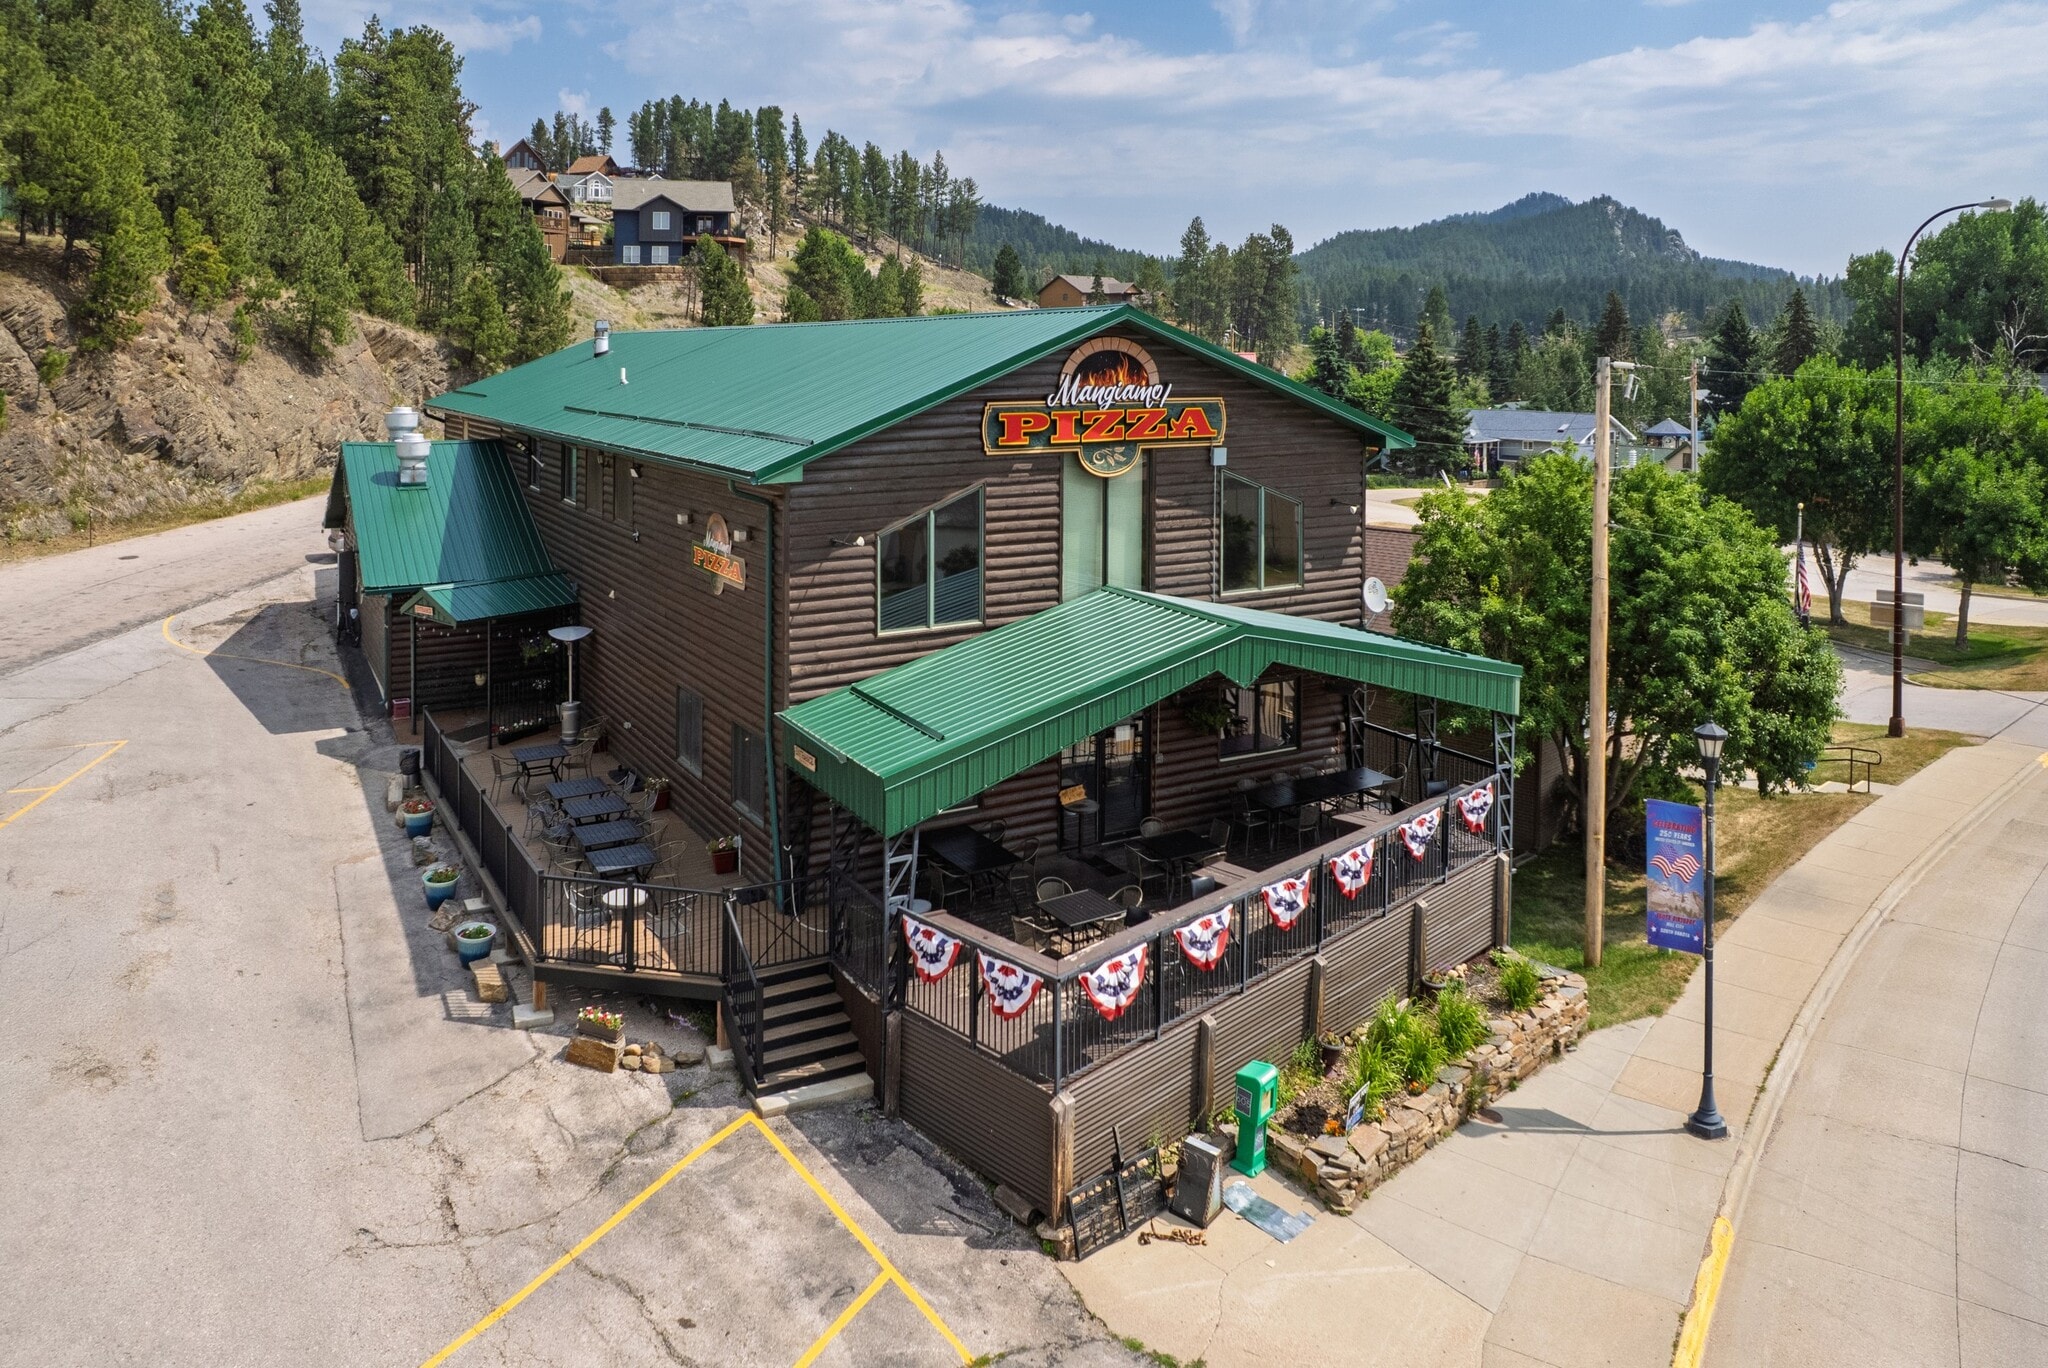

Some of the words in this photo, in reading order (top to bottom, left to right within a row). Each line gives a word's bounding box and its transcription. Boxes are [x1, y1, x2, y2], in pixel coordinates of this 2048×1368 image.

[1047, 373, 1172, 410] Mangiamo!
[998, 407, 1217, 446] PIZZA
[693, 545, 743, 584] PIZZA
[1659, 829, 1672, 838] 250
[1674, 831, 1692, 841] YEARS
